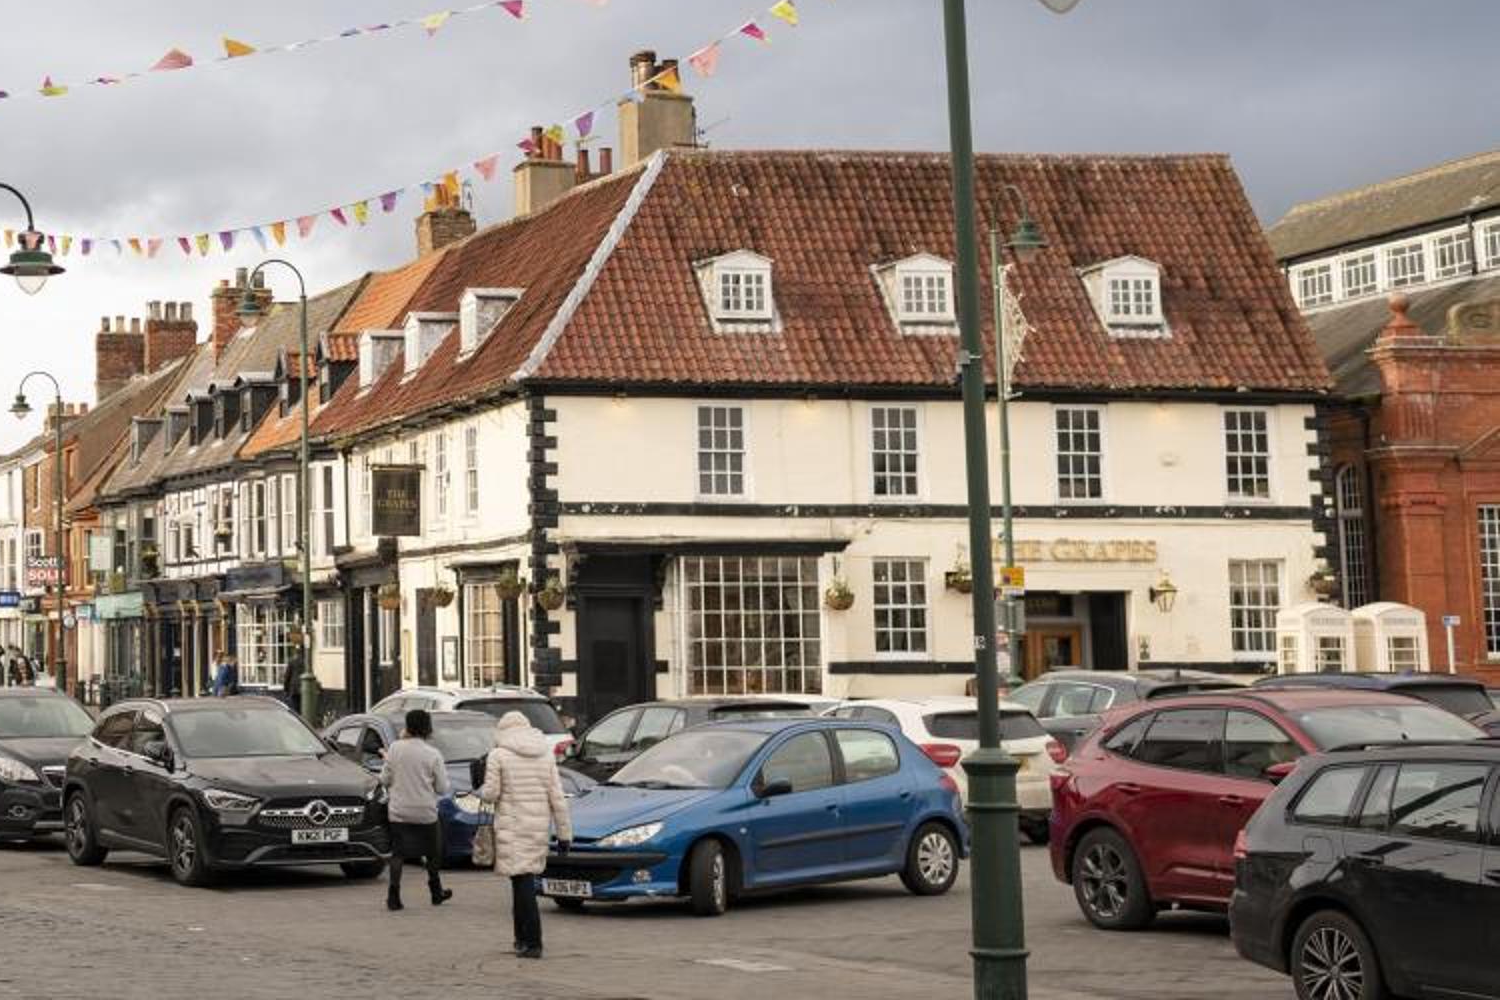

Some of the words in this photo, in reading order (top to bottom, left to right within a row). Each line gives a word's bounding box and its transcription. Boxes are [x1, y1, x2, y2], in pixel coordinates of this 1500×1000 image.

[387, 489, 406, 498] THE
[376, 499, 418, 509] GRAPES
[1050, 538, 1157, 563] GRAPES
